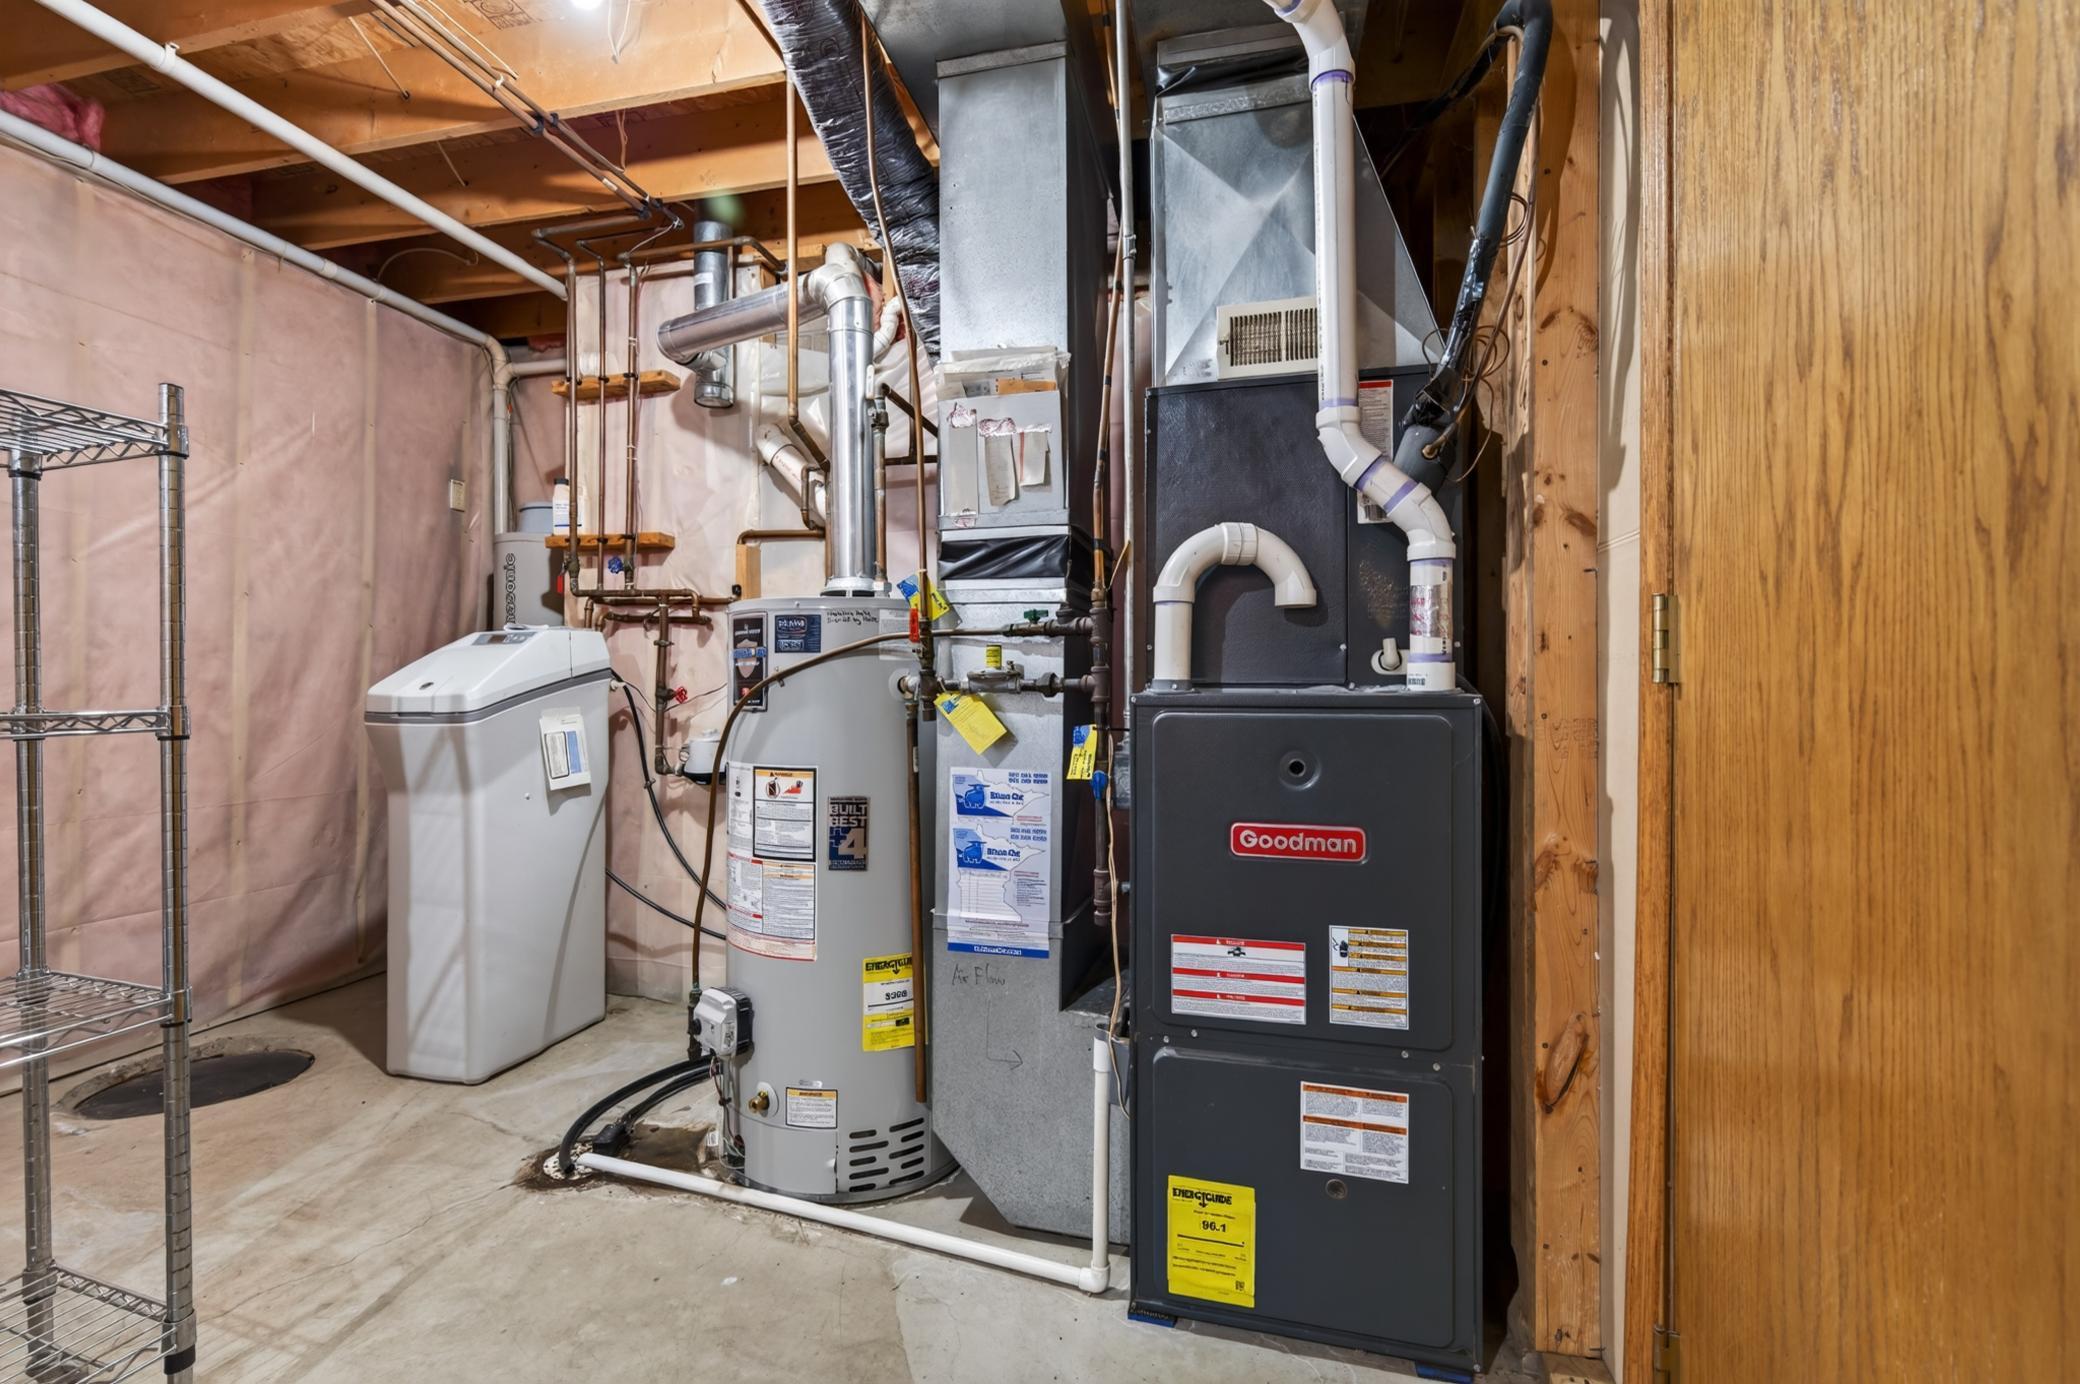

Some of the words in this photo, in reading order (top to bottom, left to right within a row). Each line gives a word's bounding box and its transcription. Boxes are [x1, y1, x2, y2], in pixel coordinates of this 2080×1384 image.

[830, 804, 868, 815] BUILT
[1239, 829, 1357, 853] Goodman
[1202, 1220, 1227, 1232] 96.1
